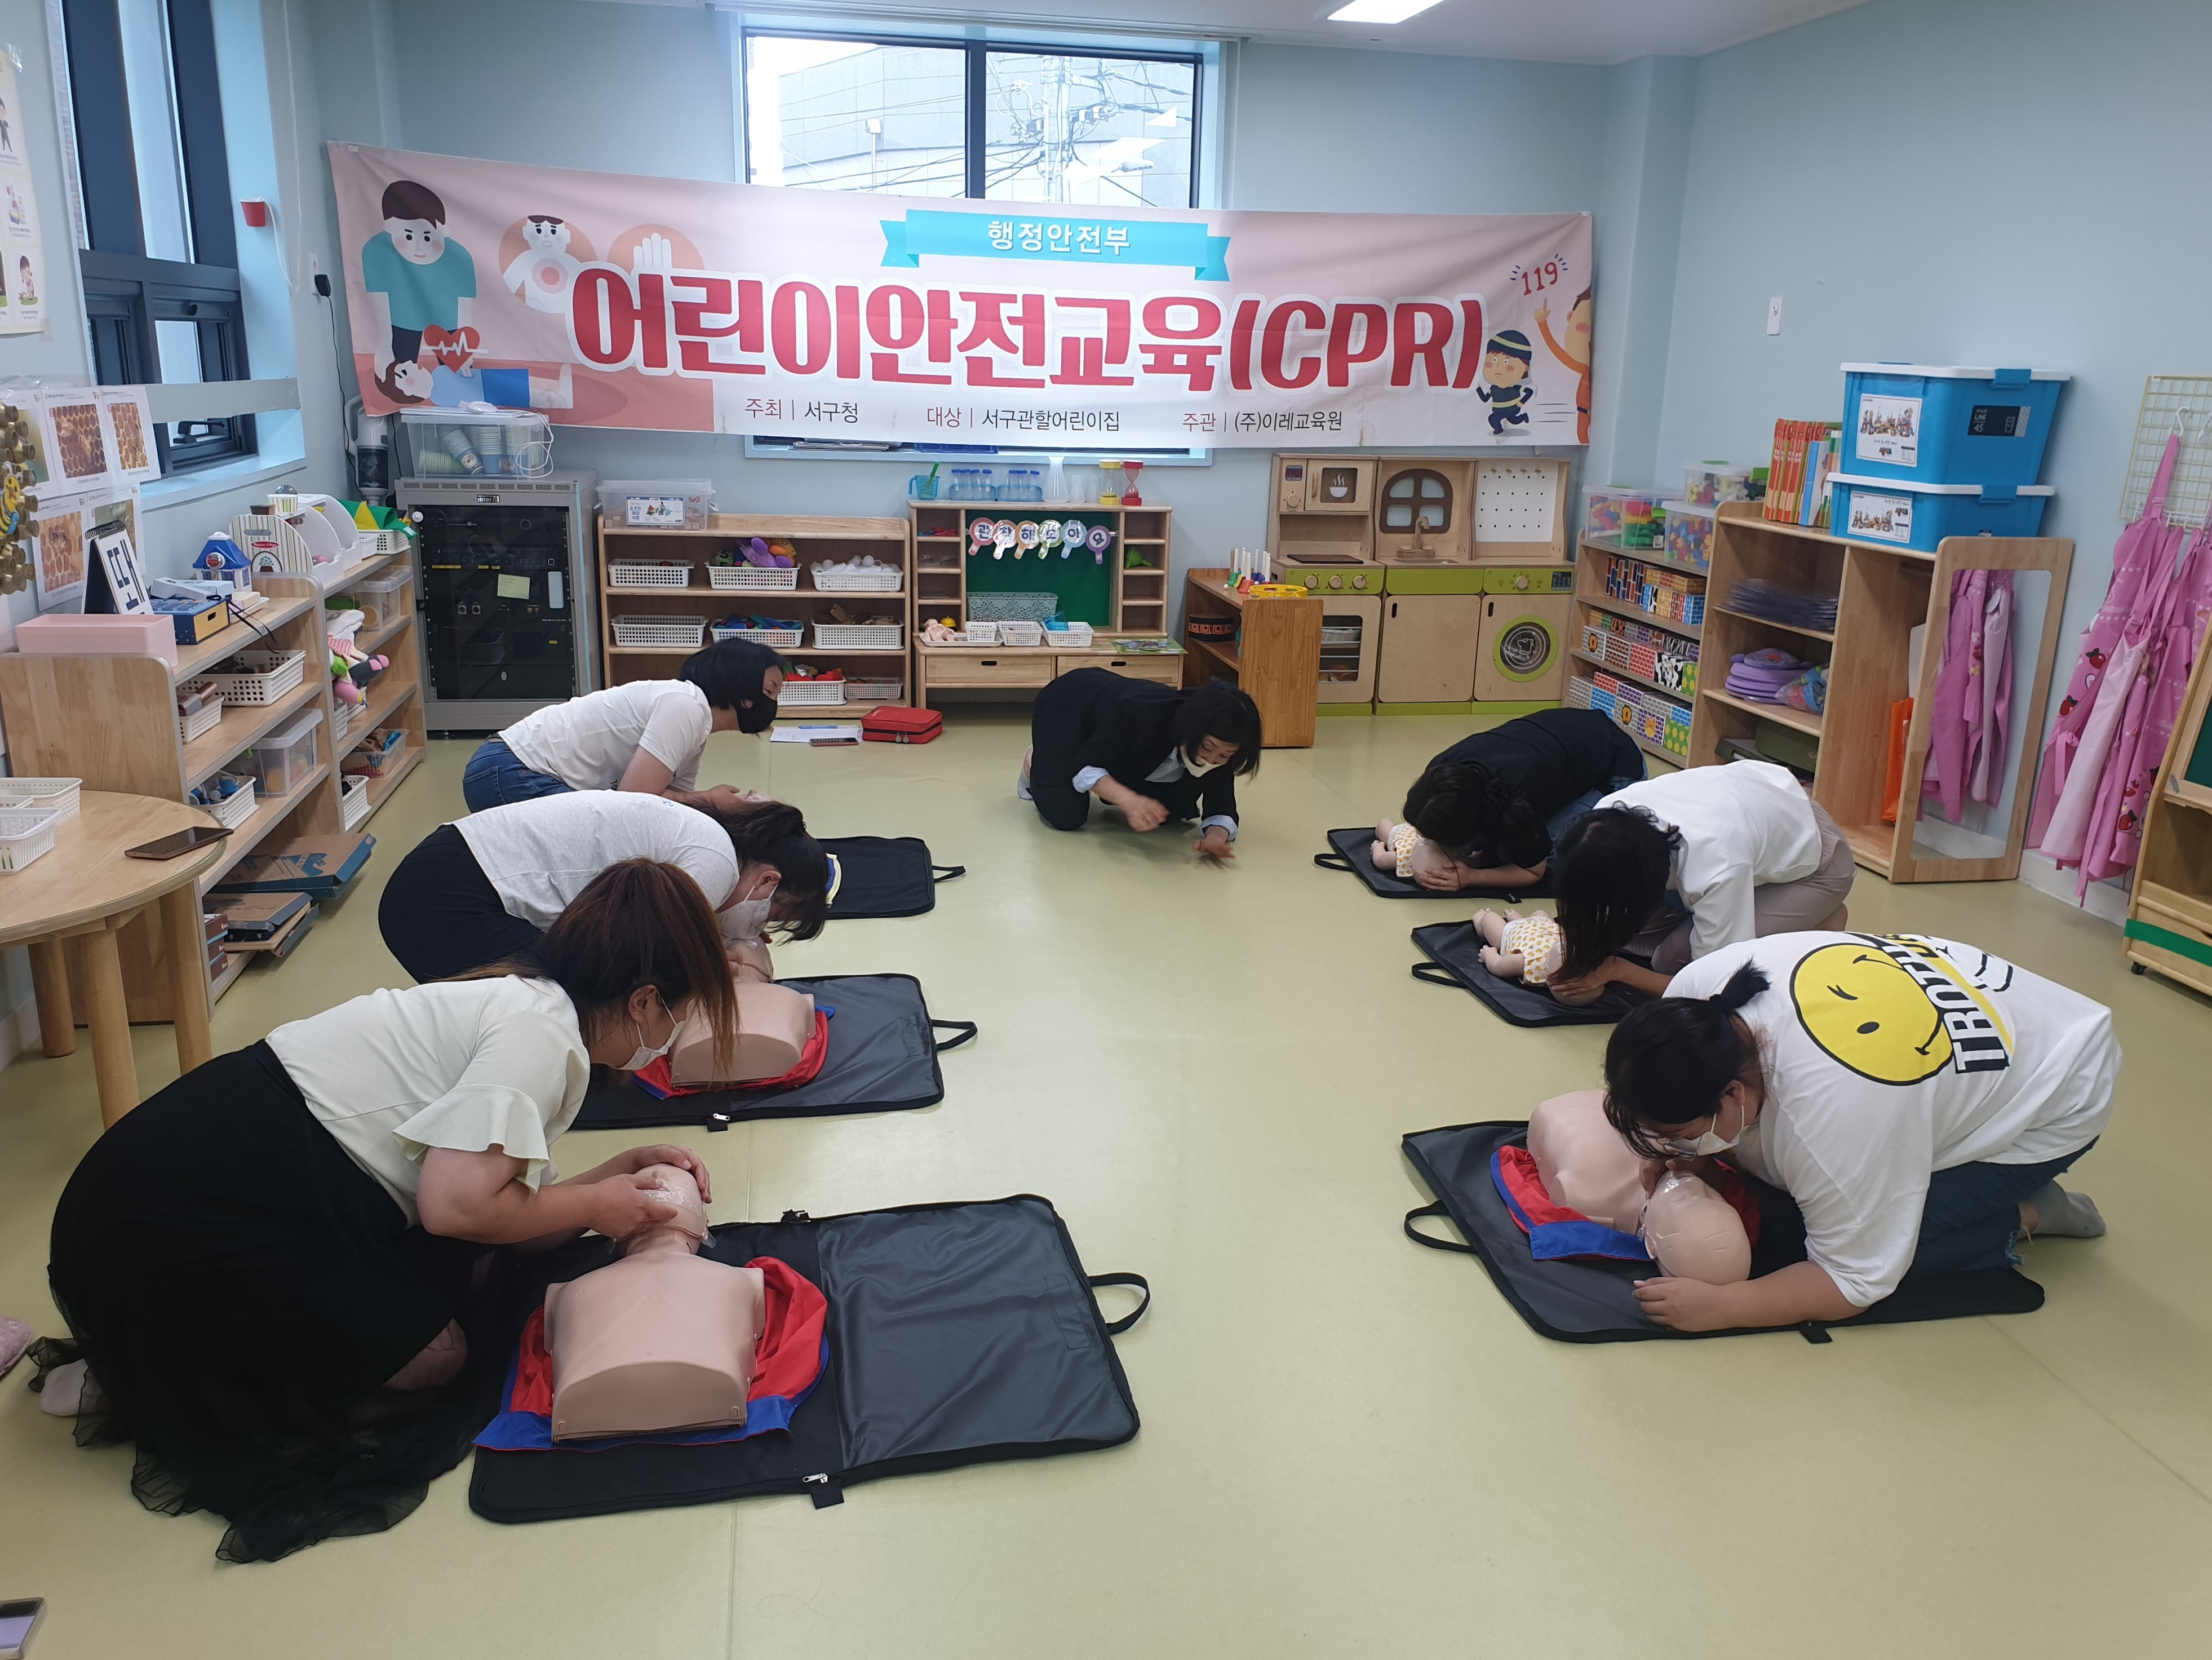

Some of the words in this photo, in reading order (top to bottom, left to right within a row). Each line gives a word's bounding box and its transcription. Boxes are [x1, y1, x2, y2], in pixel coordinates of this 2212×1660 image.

[988, 220, 1130, 255] 행정안전부
[1521, 262, 1558, 296] 119
[745, 398, 782, 419] 주최
[804, 401, 858, 423] 서구청
[927, 406, 961, 428] 대상
[982, 409, 1119, 431] 서구관할어린이집
[1183, 412, 1216, 432] 주관
[1235, 411, 1342, 432] (주)이레교육원
[1974, 424, 1983, 432] 45
